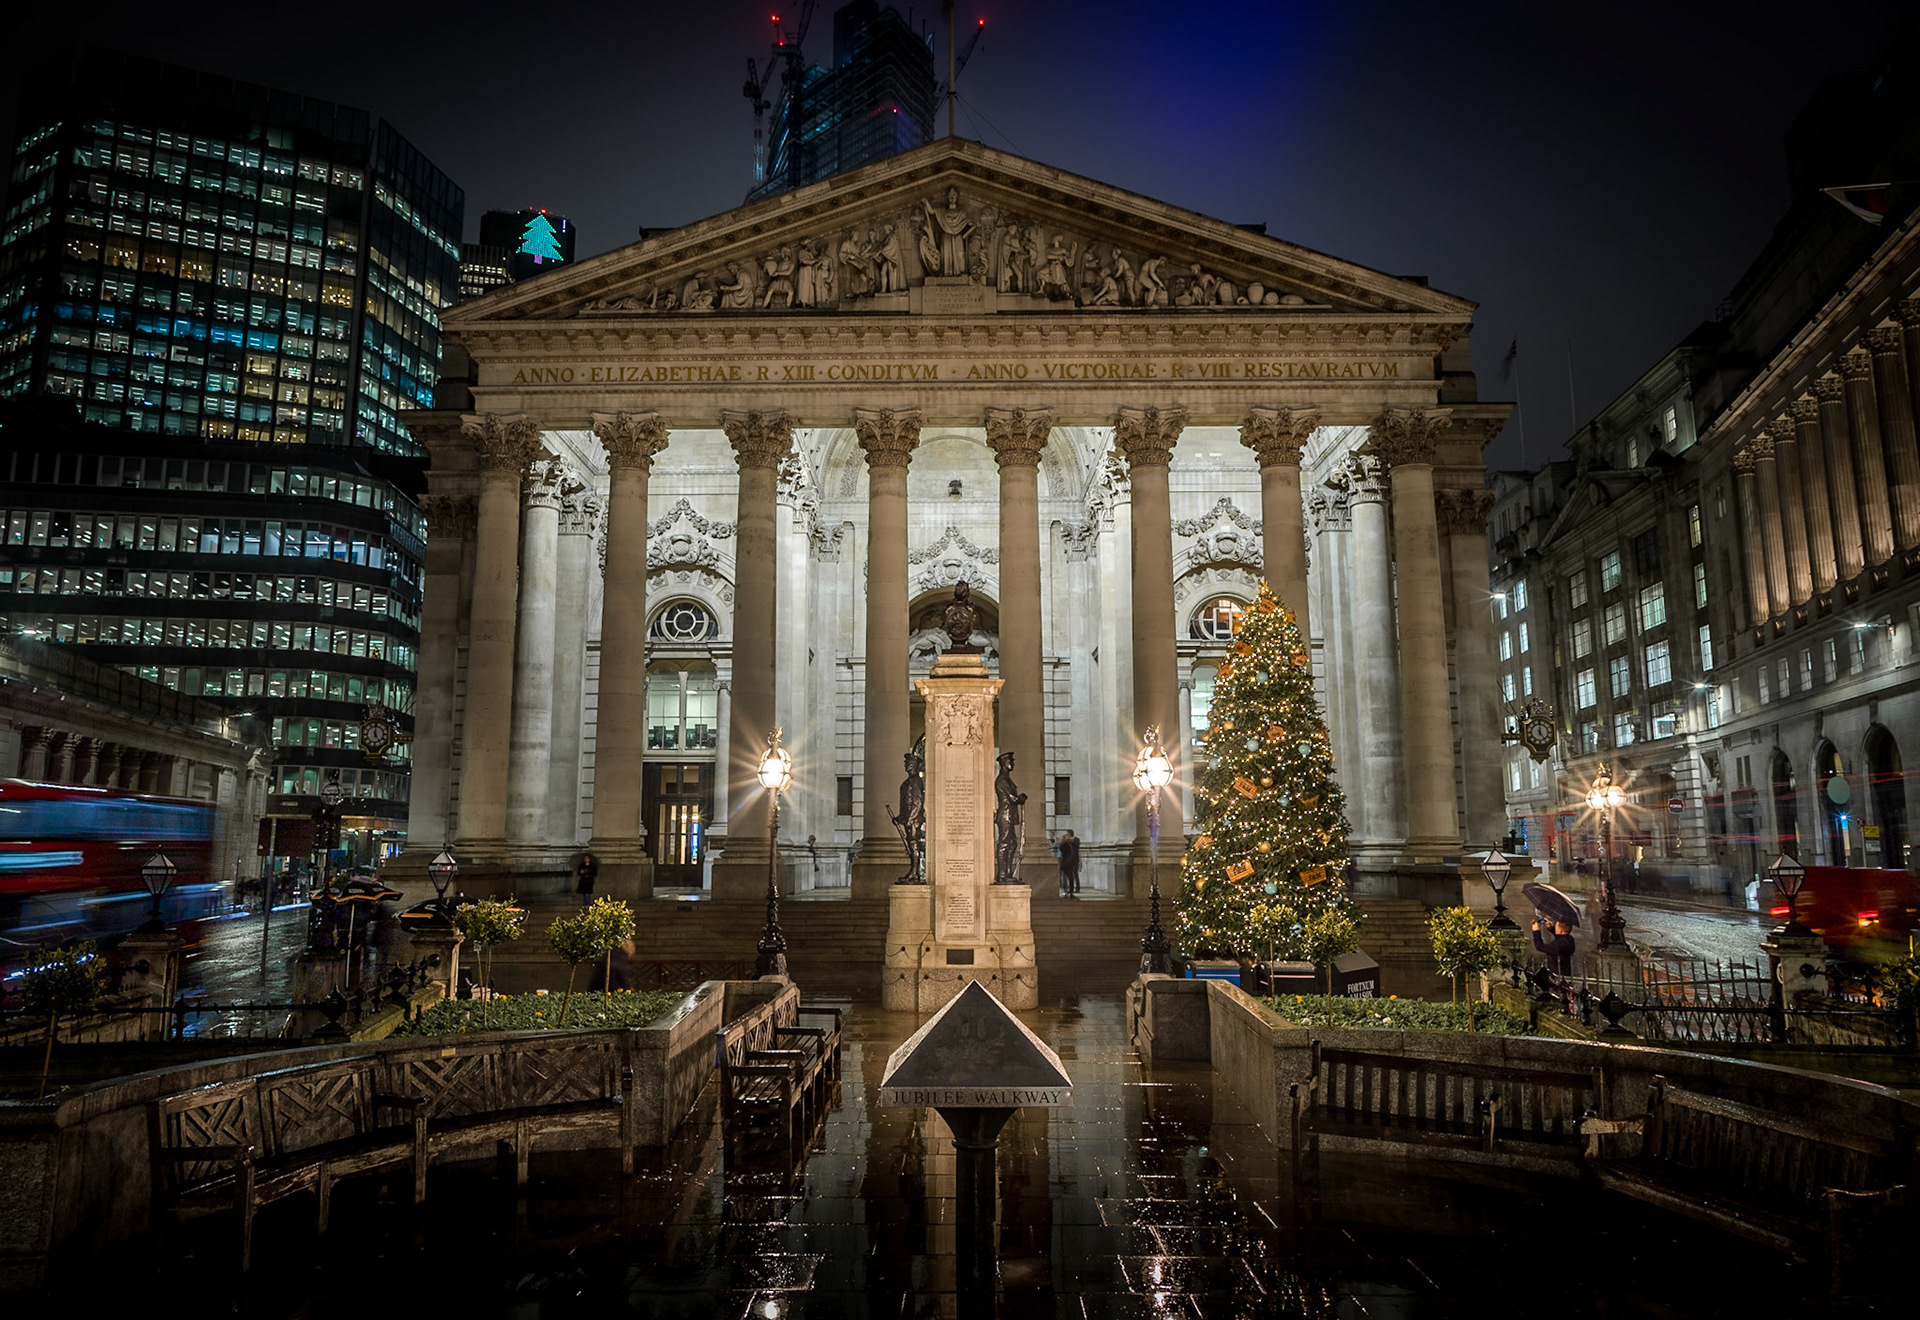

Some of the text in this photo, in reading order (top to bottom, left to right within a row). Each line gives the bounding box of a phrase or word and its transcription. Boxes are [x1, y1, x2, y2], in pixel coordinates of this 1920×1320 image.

[513, 361, 1401, 384] ANNO ELIZABETHAE R XIII CONDITVM ANNO VICTORIAE R VIII RESTAVRATVM
[1347, 979, 1375, 994] FORTNUM
[892, 1090, 1062, 1105] JUBILEE WALKWAY
